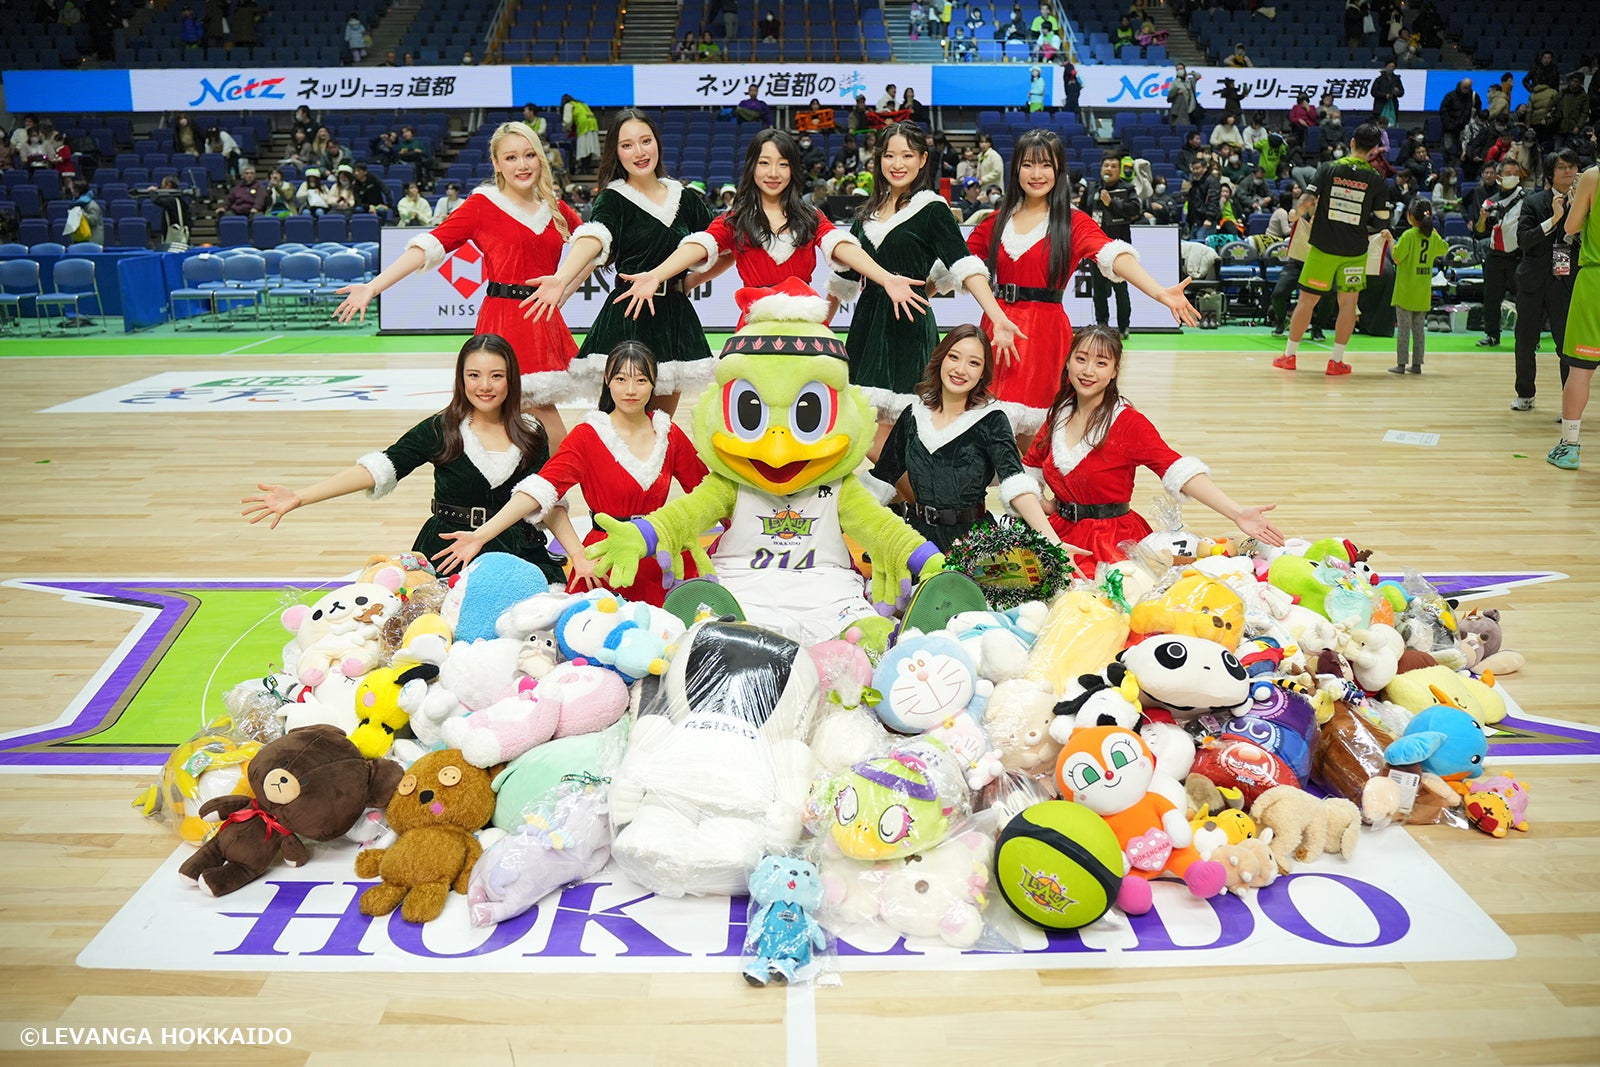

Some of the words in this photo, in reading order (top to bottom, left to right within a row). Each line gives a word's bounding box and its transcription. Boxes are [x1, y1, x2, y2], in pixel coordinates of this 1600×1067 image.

[1106, 72, 1203, 103] Net
[1418, 239, 1429, 264] 2
[438, 303, 479, 316] NISS
[1132, 841, 1171, 864] DOKINCHAN
